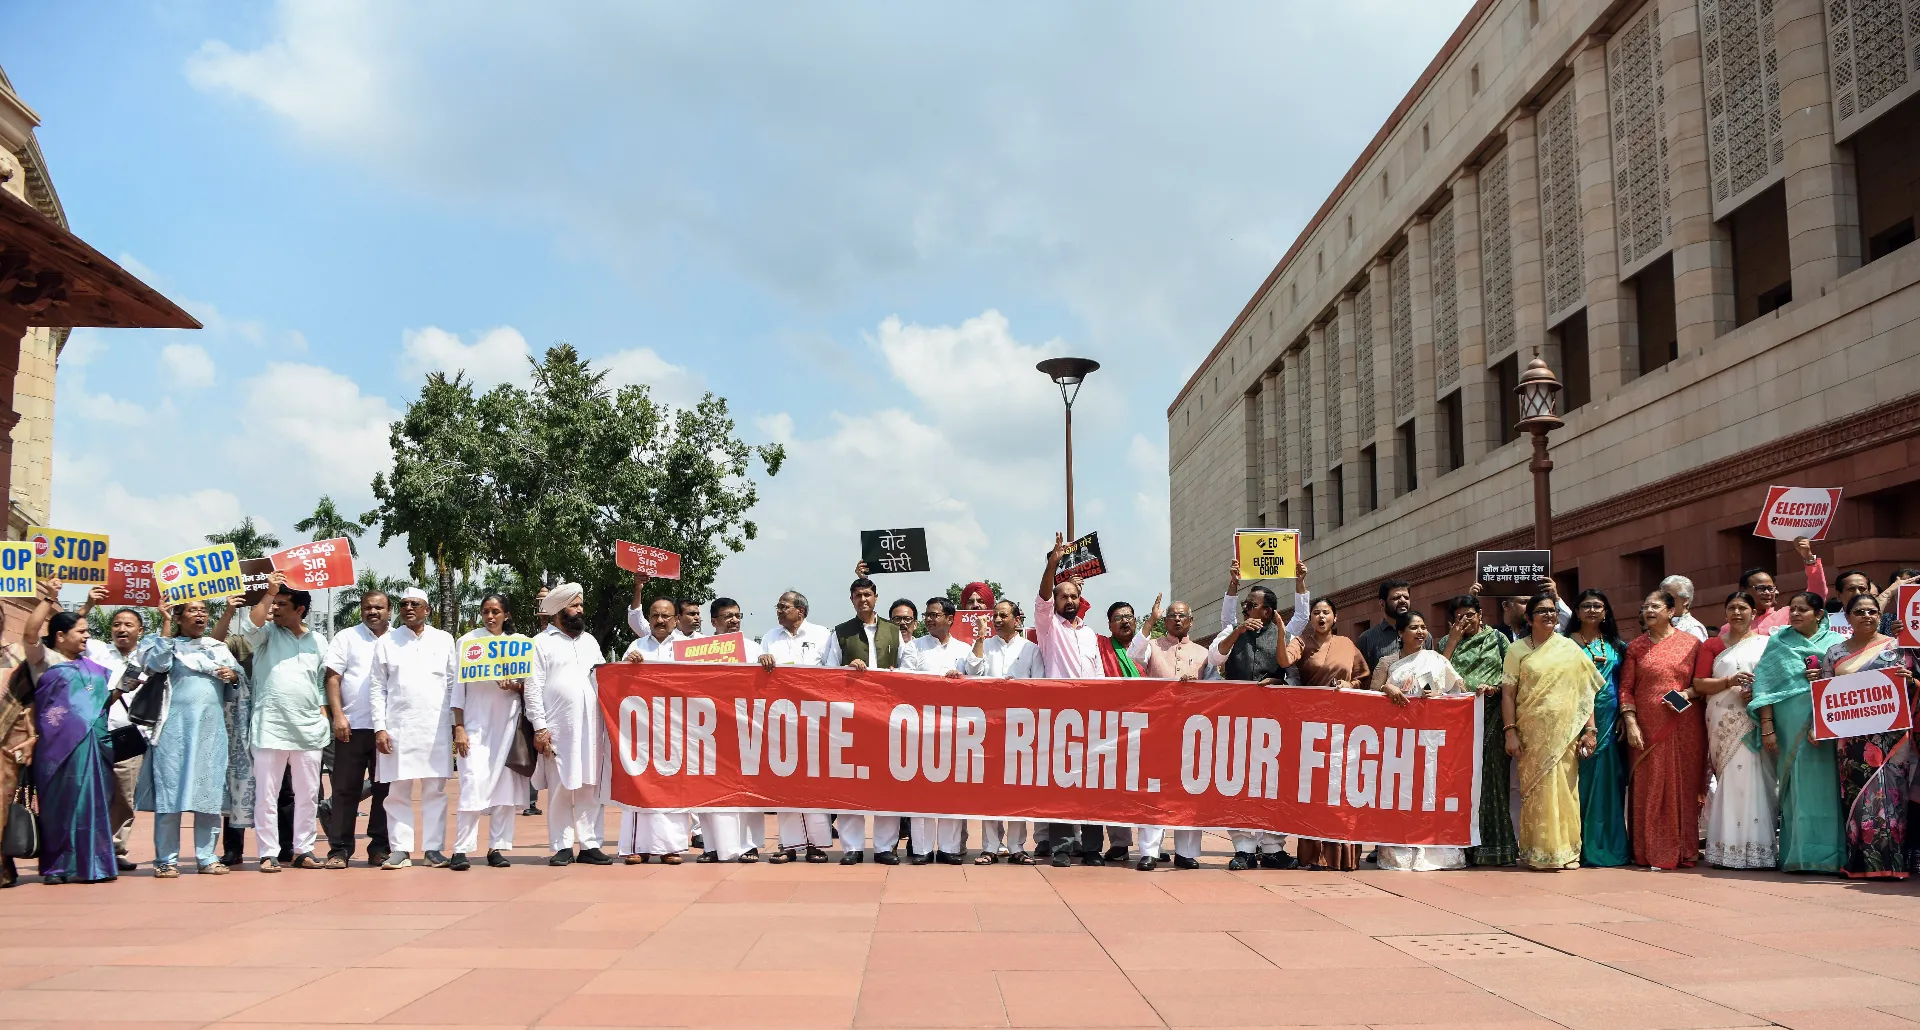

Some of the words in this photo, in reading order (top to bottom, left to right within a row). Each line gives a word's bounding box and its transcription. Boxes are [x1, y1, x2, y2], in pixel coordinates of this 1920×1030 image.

[1775, 501, 1829, 516] ELECTION
[36, 542, 48, 550] TOP
[879, 530, 906, 550] वोट
[1268, 537, 1278, 548] EC
[53, 535, 107, 561] STOP
[287, 547, 310, 560] వద్దు
[312, 542, 335, 556] వద్దు
[2, 548, 32, 571] OP
[184, 549, 235, 577] STOP
[302, 557, 327, 570] SIR
[638, 556, 657, 567] SIR
[879, 552, 911, 571] चोरी
[1253, 556, 1284, 567] ELECTION
[36, 562, 55, 578] OTE
[58, 565, 105, 581] CHORI
[161, 568, 180, 579] STOP
[1260, 566, 1278, 576] CHOR
[1482, 564, 1499, 572] खौल
[1500, 564, 1518, 572] उठेगा
[1519, 565, 1531, 574] पूरा
[1531, 563, 1544, 572] देश
[125, 578, 150, 588] SIR
[304, 571, 329, 586] వద్దు
[1482, 573, 1495, 581] वोट
[198, 575, 241, 597] CHORI
[124, 588, 151, 603] వద్దు
[972, 626, 992, 637] SR
[488, 640, 533, 659] STOP
[684, 639, 736, 658] வாக்கு
[461, 664, 490, 679] VOTE
[493, 661, 531, 676] CHORI
[1825, 685, 1893, 709] ELECTION
[618, 695, 717, 777] OUR
[735, 698, 870, 780] VOTE.
[888, 703, 987, 784] OUR
[1003, 707, 1161, 792] RIGHT.
[1180, 714, 1282, 799] OUR
[1298, 721, 1459, 812] FIGHT.
